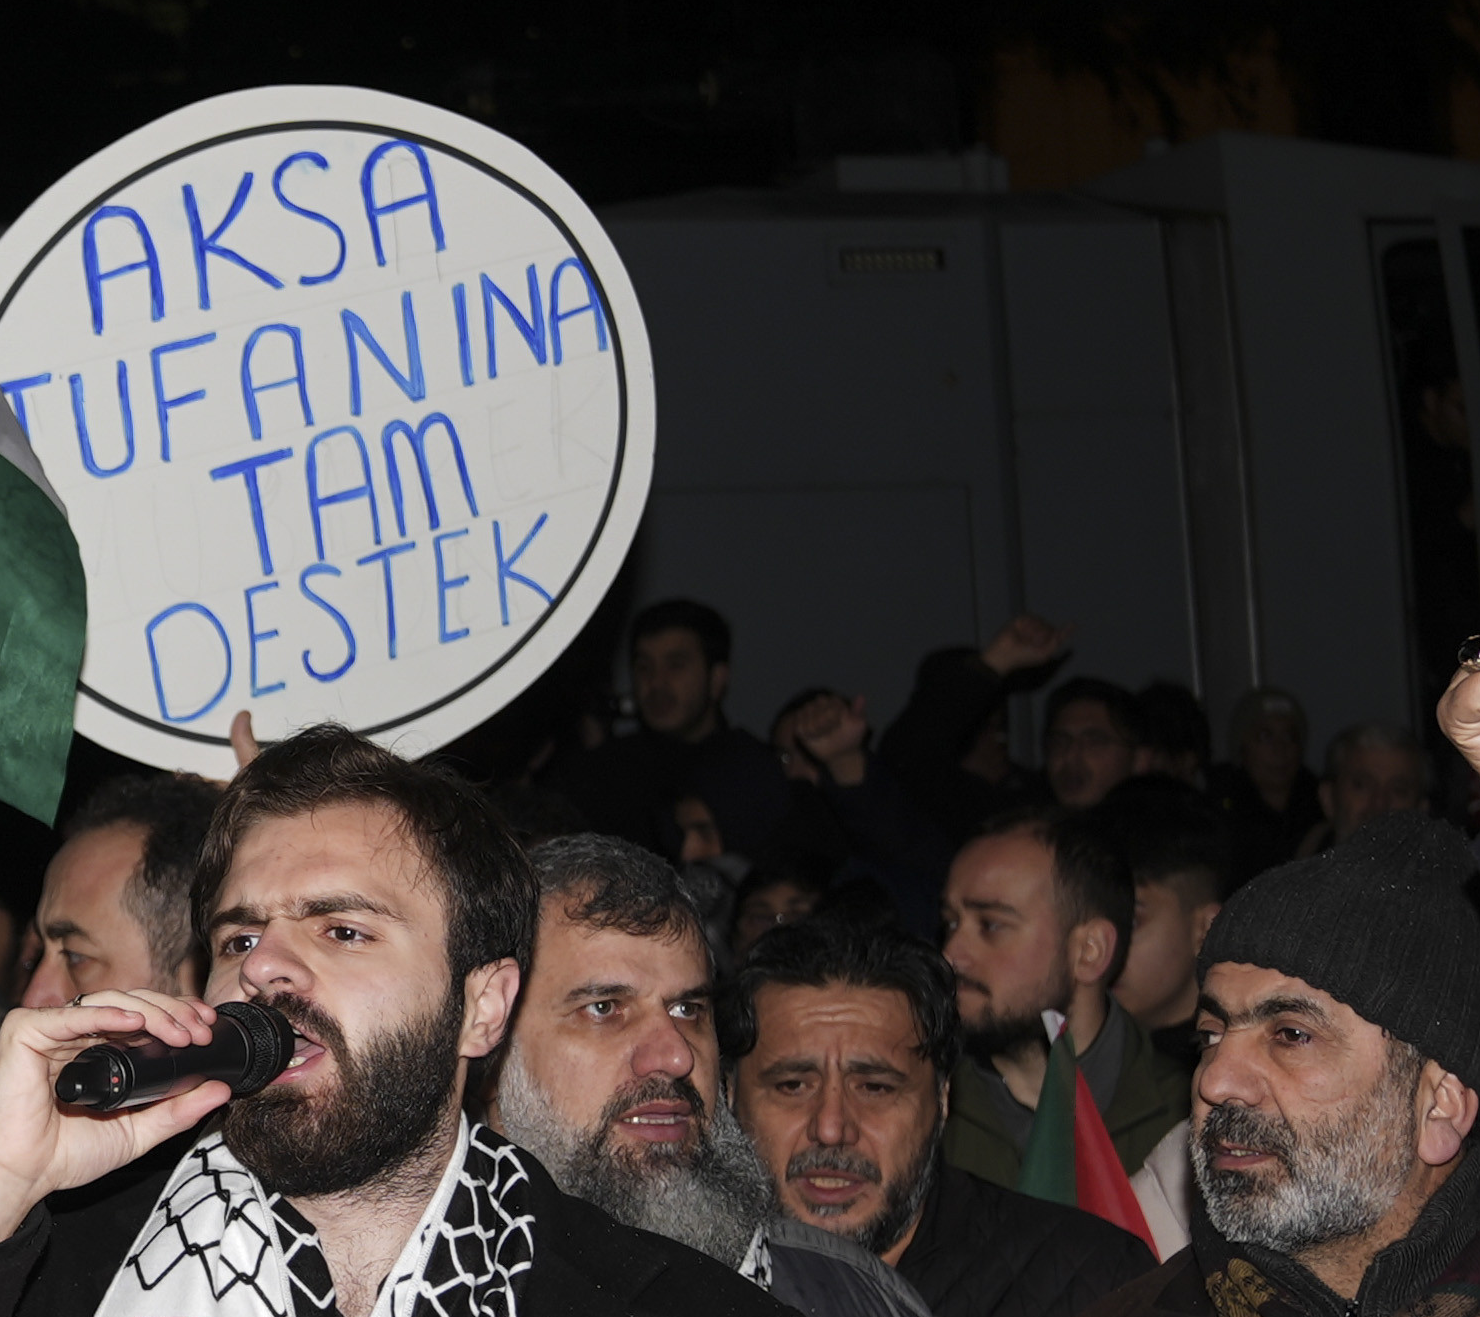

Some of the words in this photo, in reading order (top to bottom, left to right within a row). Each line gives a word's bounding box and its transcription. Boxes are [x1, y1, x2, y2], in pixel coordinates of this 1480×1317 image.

[82, 139, 445, 335] AKSA
[209, 411, 480, 576] TAM
[144, 513, 556, 723] DESTEK
